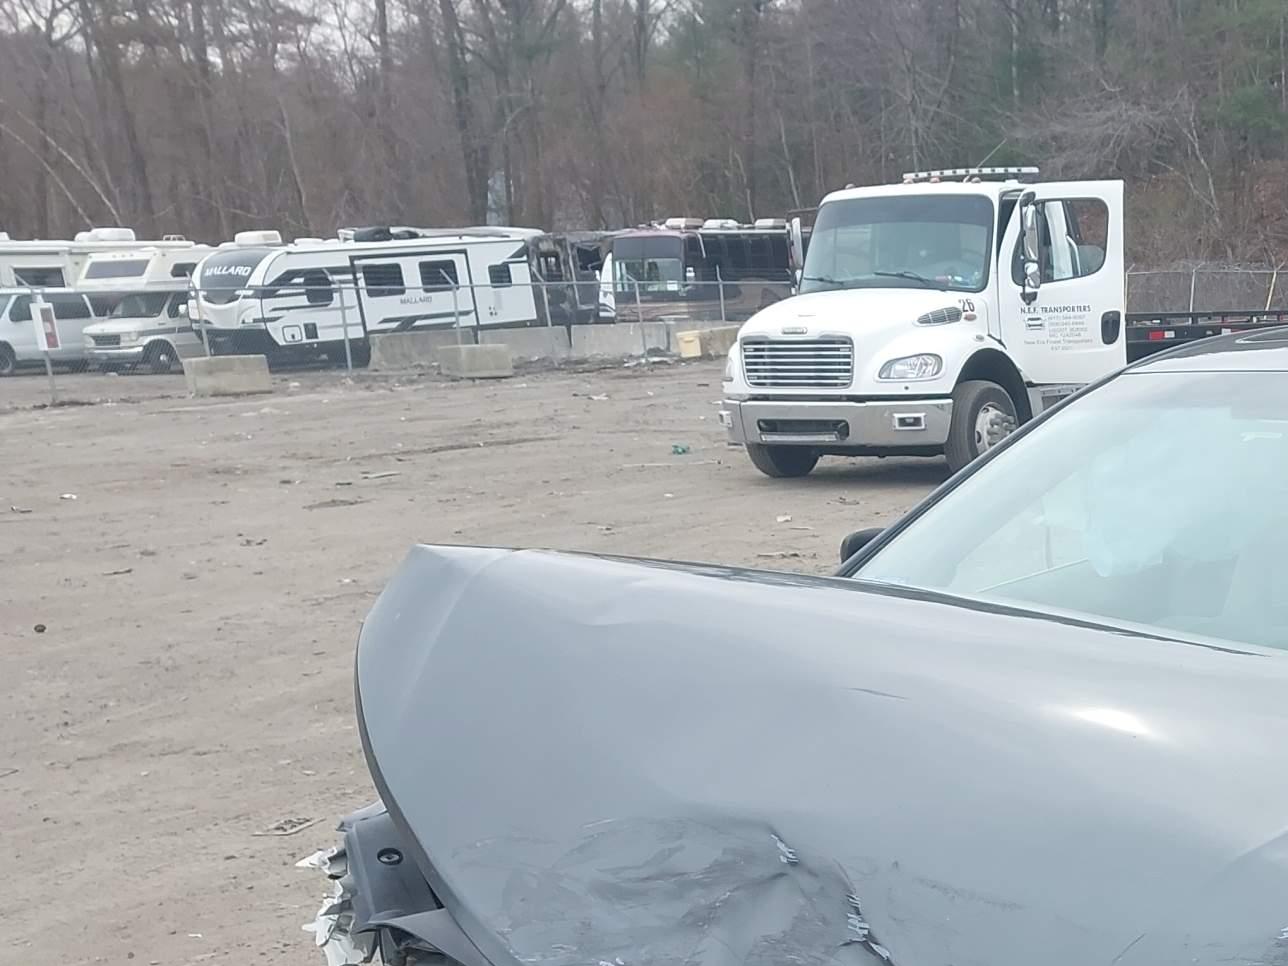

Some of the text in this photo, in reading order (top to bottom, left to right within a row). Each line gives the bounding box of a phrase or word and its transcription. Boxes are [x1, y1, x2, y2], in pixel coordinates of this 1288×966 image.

[204, 265, 252, 277] MALLARD
[958, 299, 975, 312] 26
[1041, 304, 1092, 314] TRANSPORTERS
